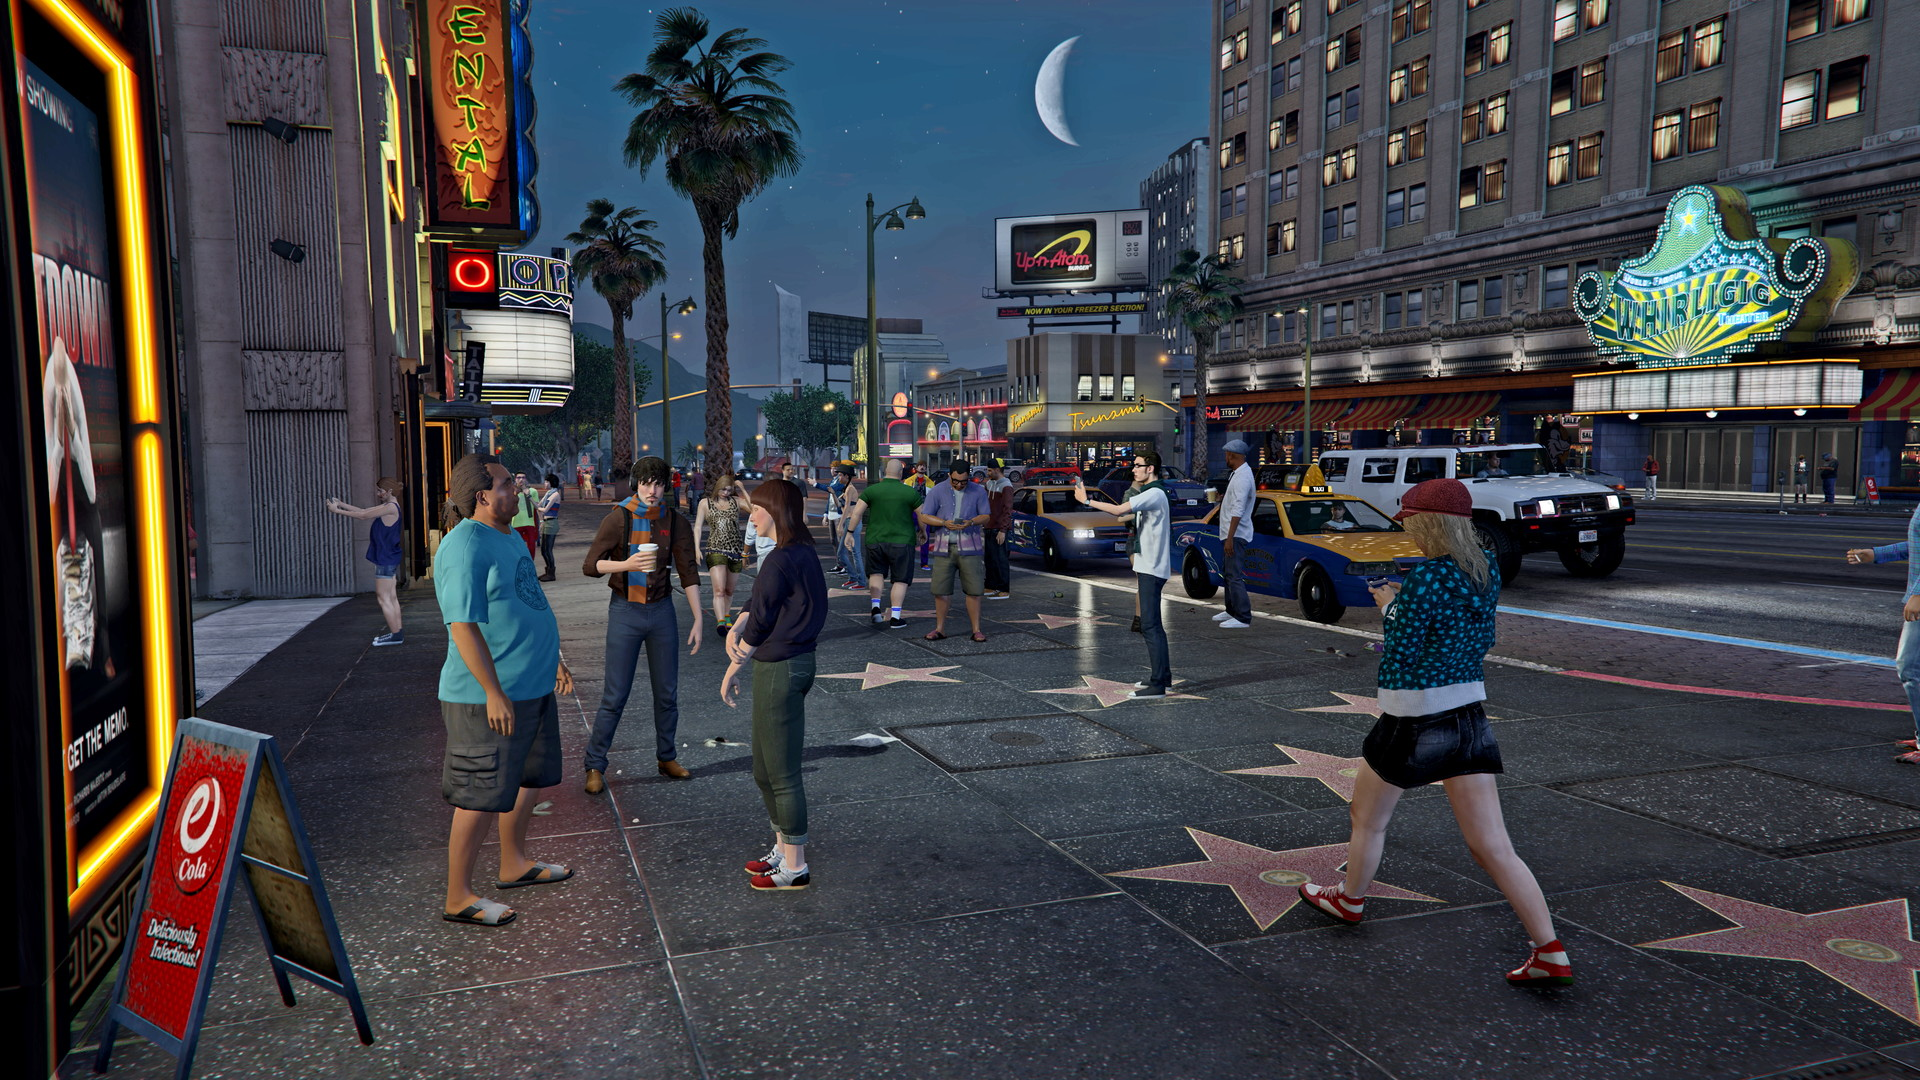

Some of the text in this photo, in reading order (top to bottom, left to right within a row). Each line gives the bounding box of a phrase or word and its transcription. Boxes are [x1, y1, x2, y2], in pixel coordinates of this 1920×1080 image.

[26, 74, 74, 133] SHOWING
[447, 5, 490, 211] ENTAL
[1054, 306, 1074, 314] YOUR
[1075, 305, 1109, 313] FREEZER
[1110, 304, 1145, 312] SECTION!
[1613, 280, 1771, 341] WHIRLIGIG
[1718, 311, 1769, 325] THEATER
[463, 346, 482, 428] TATTOS
[67, 706, 129, 771] GET THE MEMO.
[179, 859, 206, 881] Cola
[147, 918, 198, 949] Deliciously
[150, 940, 201, 967] Infectious!
